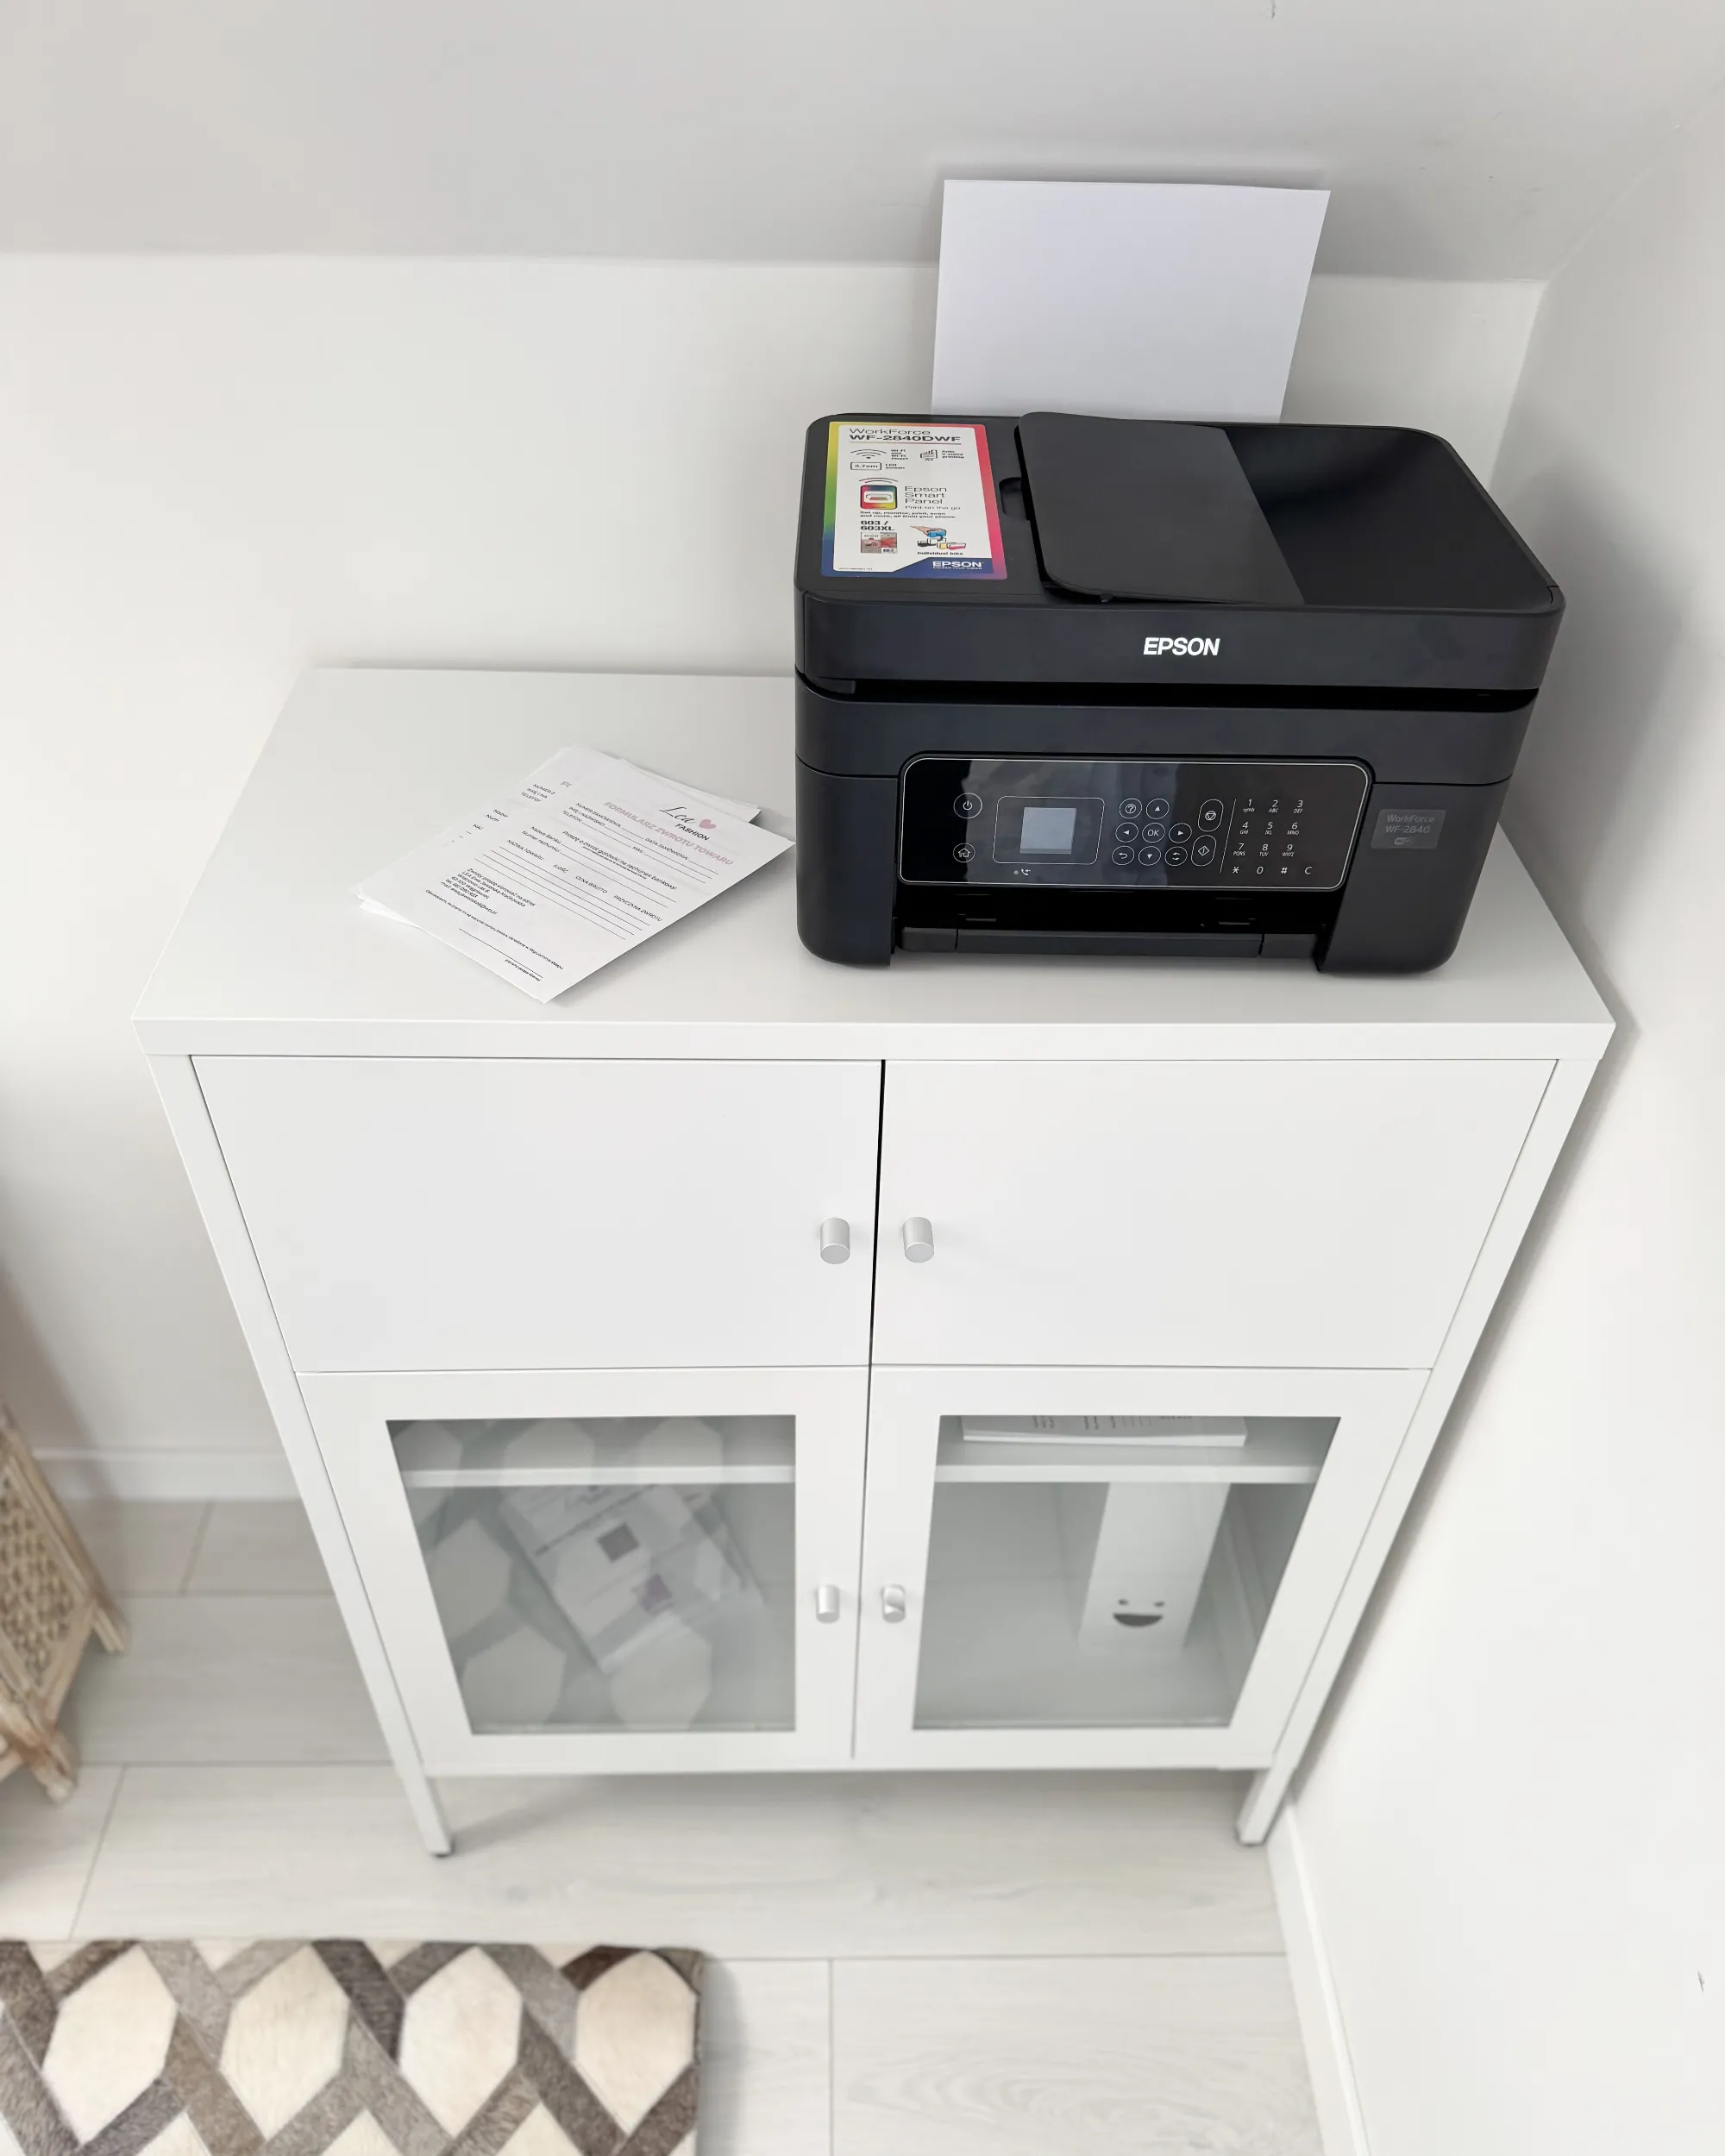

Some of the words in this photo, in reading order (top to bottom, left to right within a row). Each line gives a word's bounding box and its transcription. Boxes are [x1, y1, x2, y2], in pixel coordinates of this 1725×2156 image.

[1143, 637, 1220, 656] EPSON
[1271, 799, 1278, 808] 2
[1296, 799, 1303, 808] 3
[659, 805, 696, 824] Lea
[1387, 814, 1435, 823] WorkForce
[1242, 821, 1249, 830] 4
[1385, 825, 1431, 834] WF-2840
[604, 801, 656, 831] FORMULARZ
[654, 826, 695, 849] ZWROTU
[693, 844, 735, 866] TOWARU
[675, 822, 711, 842] FASHION
[626, 863, 653, 877] rachunek
[1304, 866, 1312, 874] C
